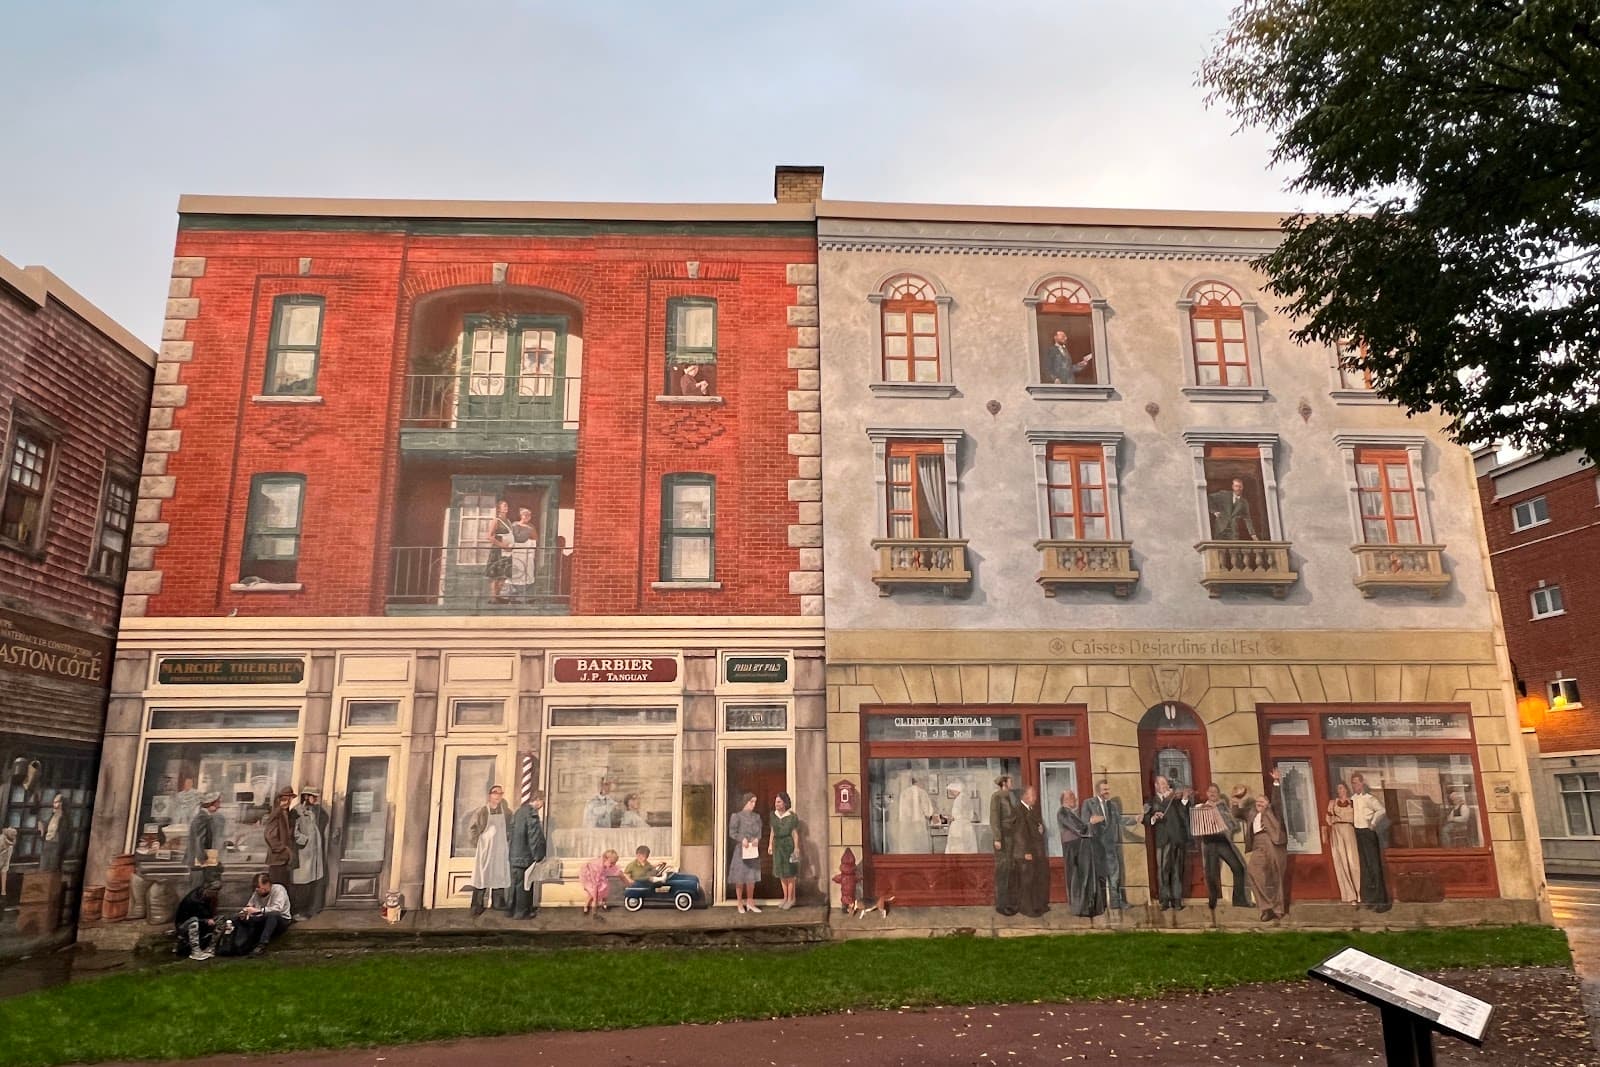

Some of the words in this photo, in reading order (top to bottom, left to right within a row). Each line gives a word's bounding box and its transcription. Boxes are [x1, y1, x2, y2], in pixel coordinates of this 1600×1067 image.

[1071, 638, 1125, 655] Caisses
[1129, 638, 1206, 657] Desjardins
[577, 659, 653, 671] BARBIER
[606, 673, 649, 681] TANGUAY
[894, 717, 940, 727] CLINIQUE
